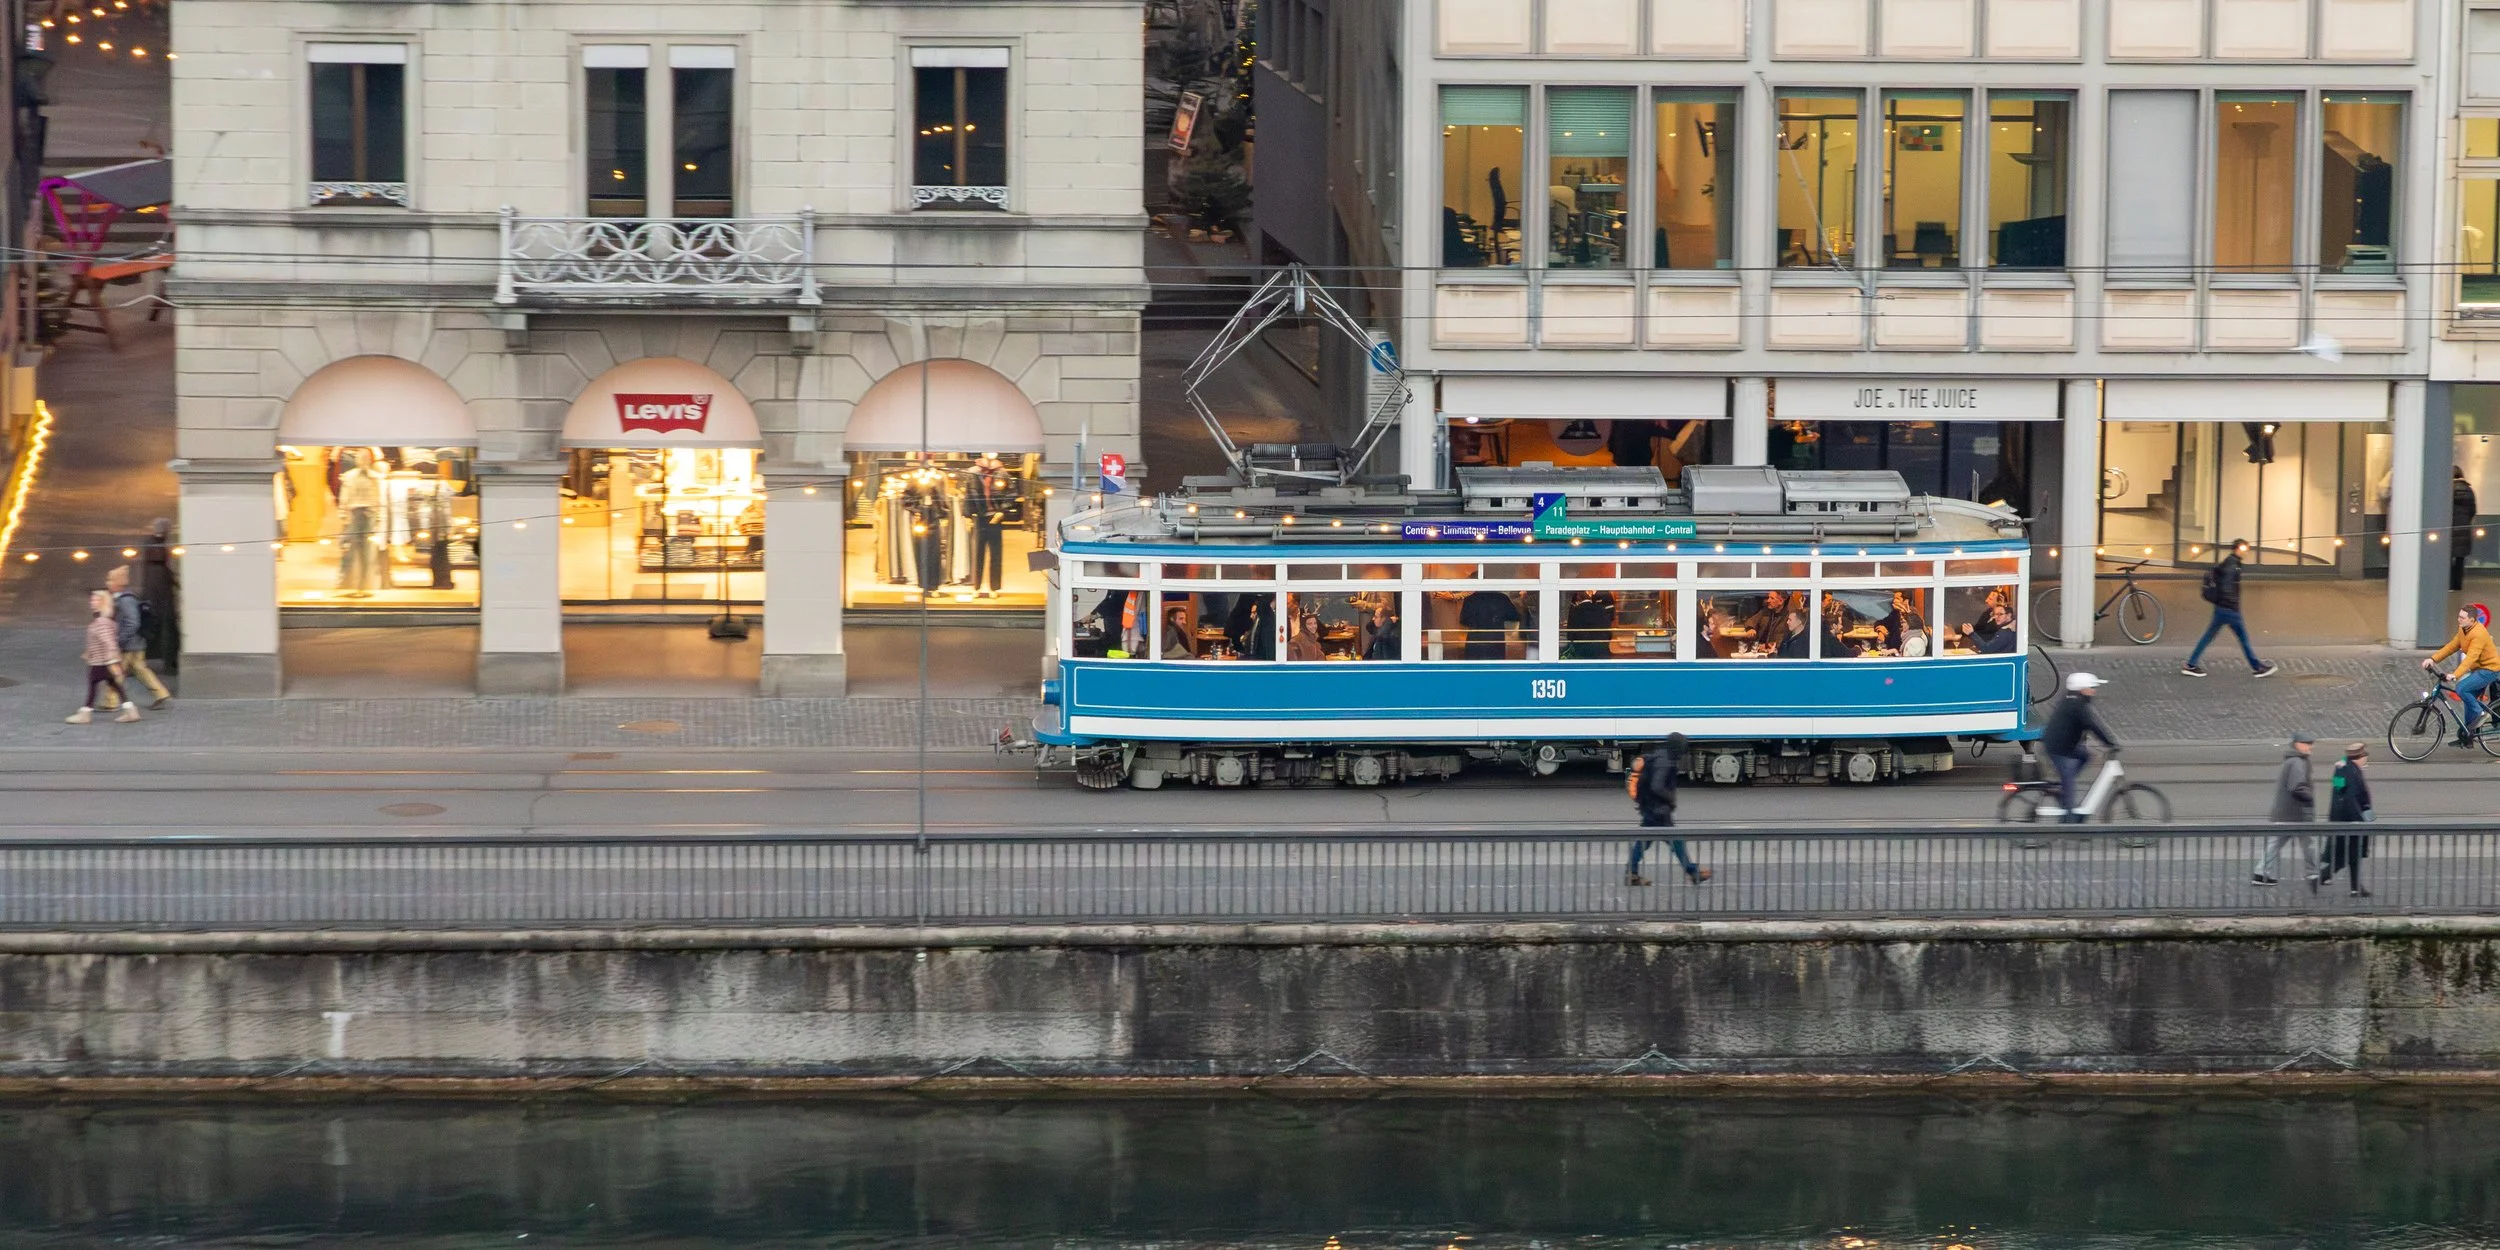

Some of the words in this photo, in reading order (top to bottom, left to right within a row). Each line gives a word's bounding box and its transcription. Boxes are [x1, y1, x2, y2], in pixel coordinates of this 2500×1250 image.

[1854, 388, 1883, 408] JOE
[1898, 388, 1928, 408] THE
[1932, 388, 1978, 408] JUICE
[1538, 497, 1545, 507] 4
[1552, 506, 1563, 517] 11
[1405, 525, 1433, 535] Centra
[1443, 525, 1489, 537] Limmatquai
[1498, 525, 1532, 535] Bellevue
[1545, 525, 1590, 535] Paradeplatz
[1600, 525, 1655, 535] Hauptbahnhof
[1665, 525, 1693, 535] Central
[1531, 679, 1566, 699] 1350
